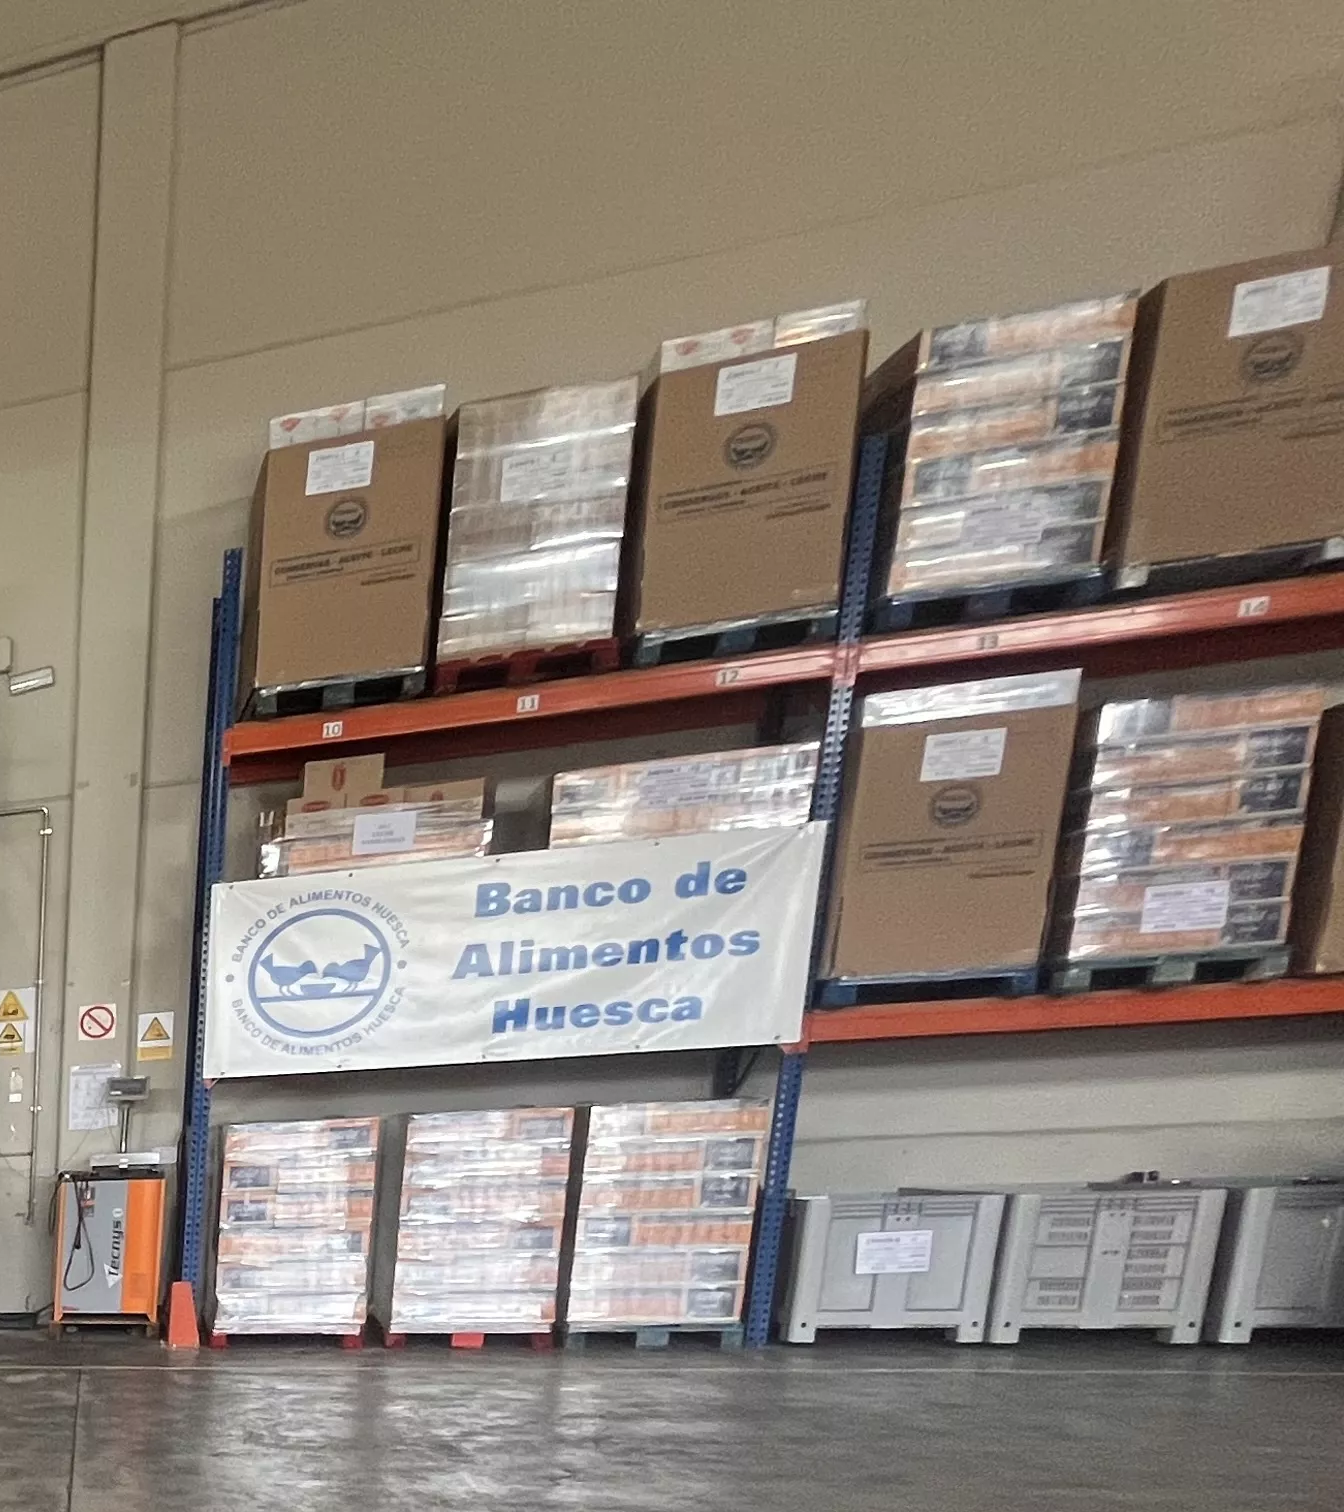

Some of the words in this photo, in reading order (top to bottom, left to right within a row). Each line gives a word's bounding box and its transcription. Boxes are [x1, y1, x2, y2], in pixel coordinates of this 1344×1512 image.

[520, 697, 536, 710] 11
[720, 670, 739, 685] 12
[473, 876, 652, 918] Banco
[674, 860, 748, 899] de
[231, 918, 267, 963] BANCO
[266, 902, 287, 921] DE
[288, 889, 372, 909] ALIMENTOS
[371, 901, 411, 949] HUESCA
[450, 928, 761, 980] Alimentos
[231, 998, 263, 1039] BANCO
[260, 1034, 280, 1052] DE
[279, 1031, 363, 1056] ALIMENTOS
[362, 985, 407, 1037] HUESCA
[491, 995, 704, 1034] Huesca
